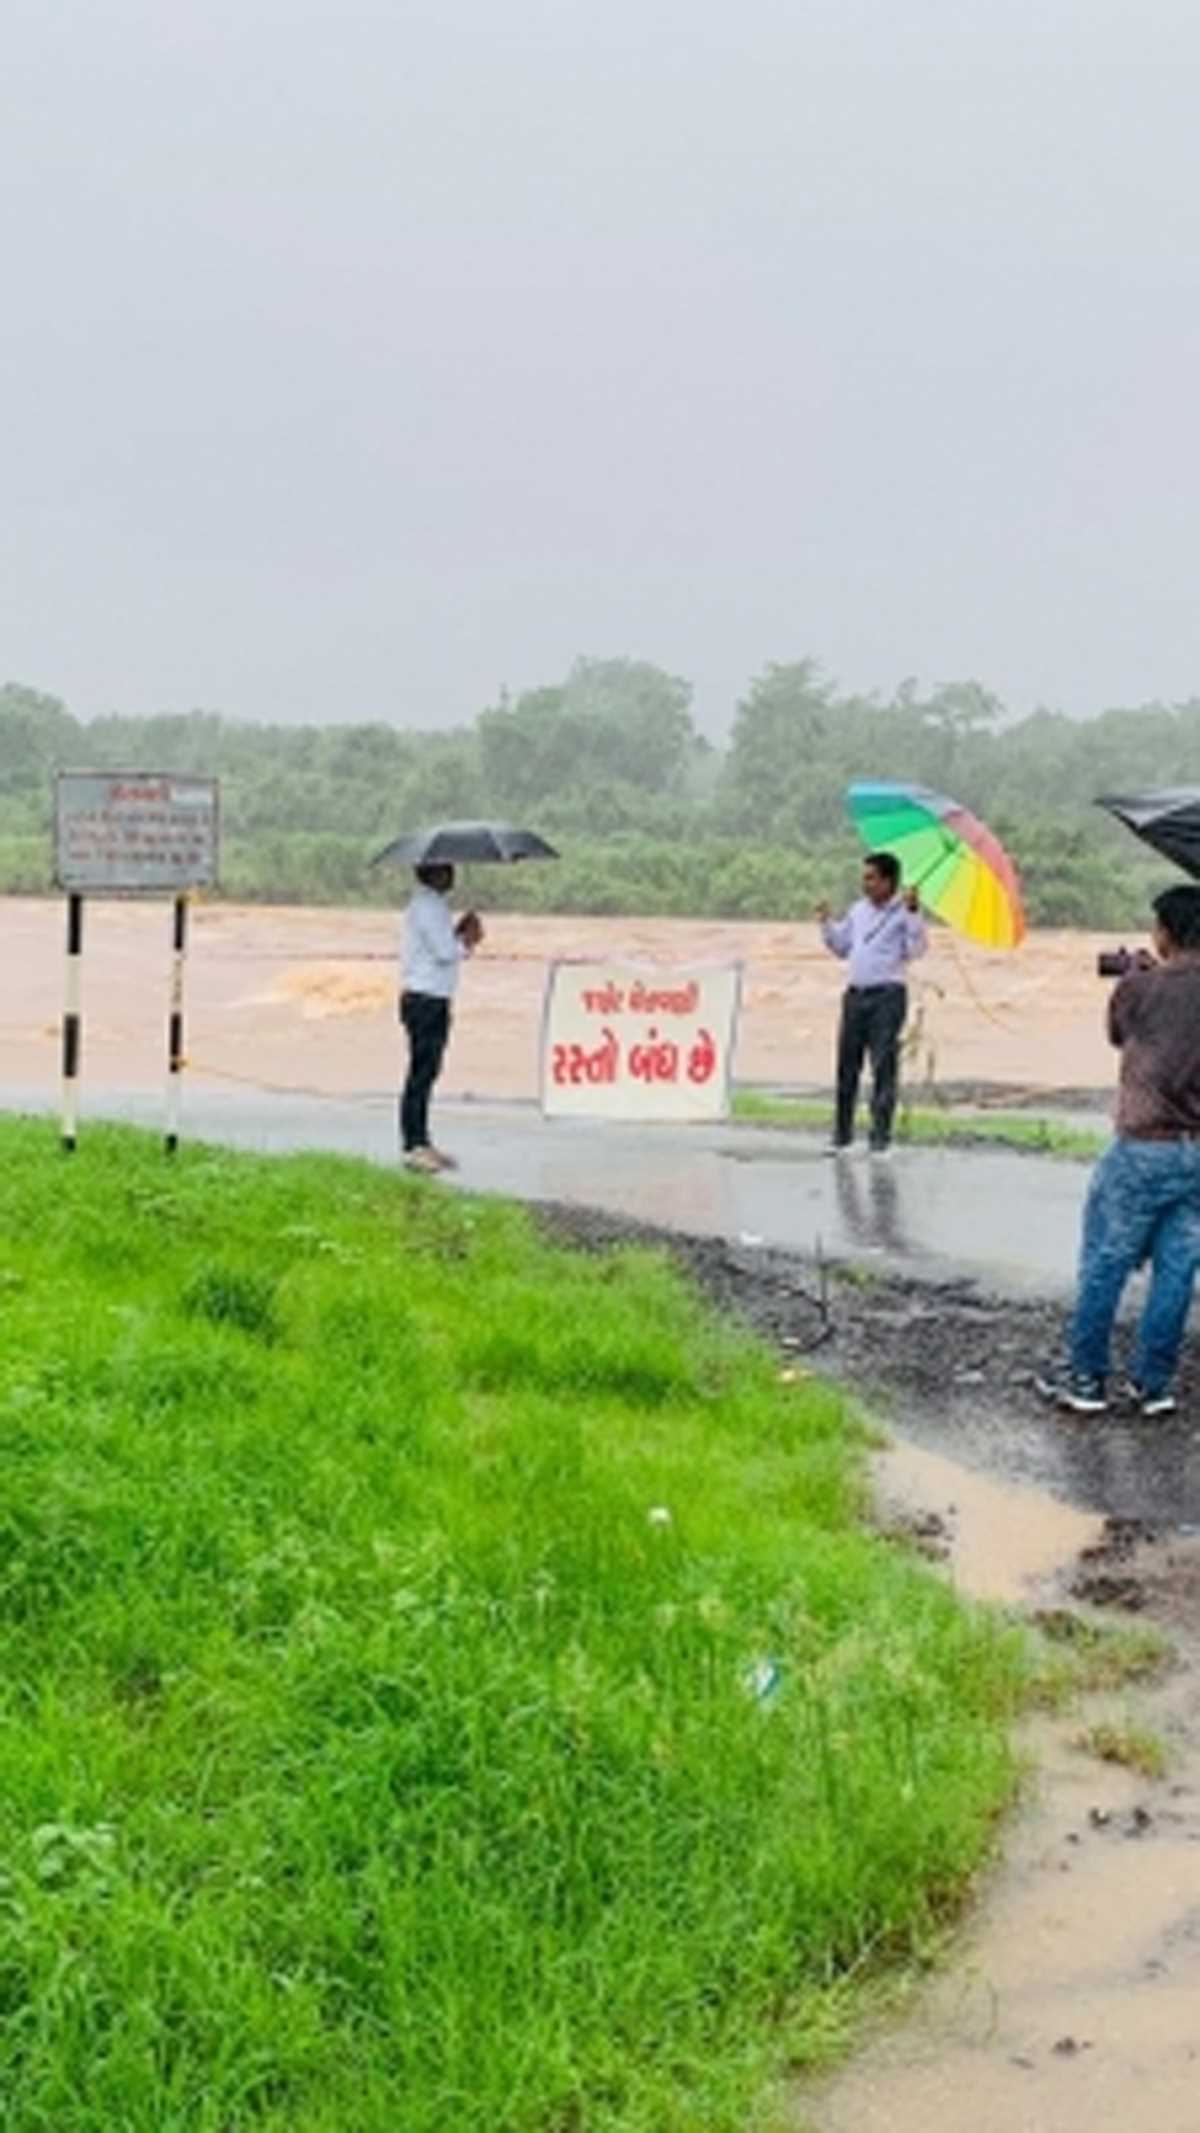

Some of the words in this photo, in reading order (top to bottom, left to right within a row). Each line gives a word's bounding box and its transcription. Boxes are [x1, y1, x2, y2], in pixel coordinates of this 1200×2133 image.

[553, 1027, 618, 1083] રસ્તો
[628, 1027, 678, 1083] બંધ
[687, 1027, 715, 1083] છે
